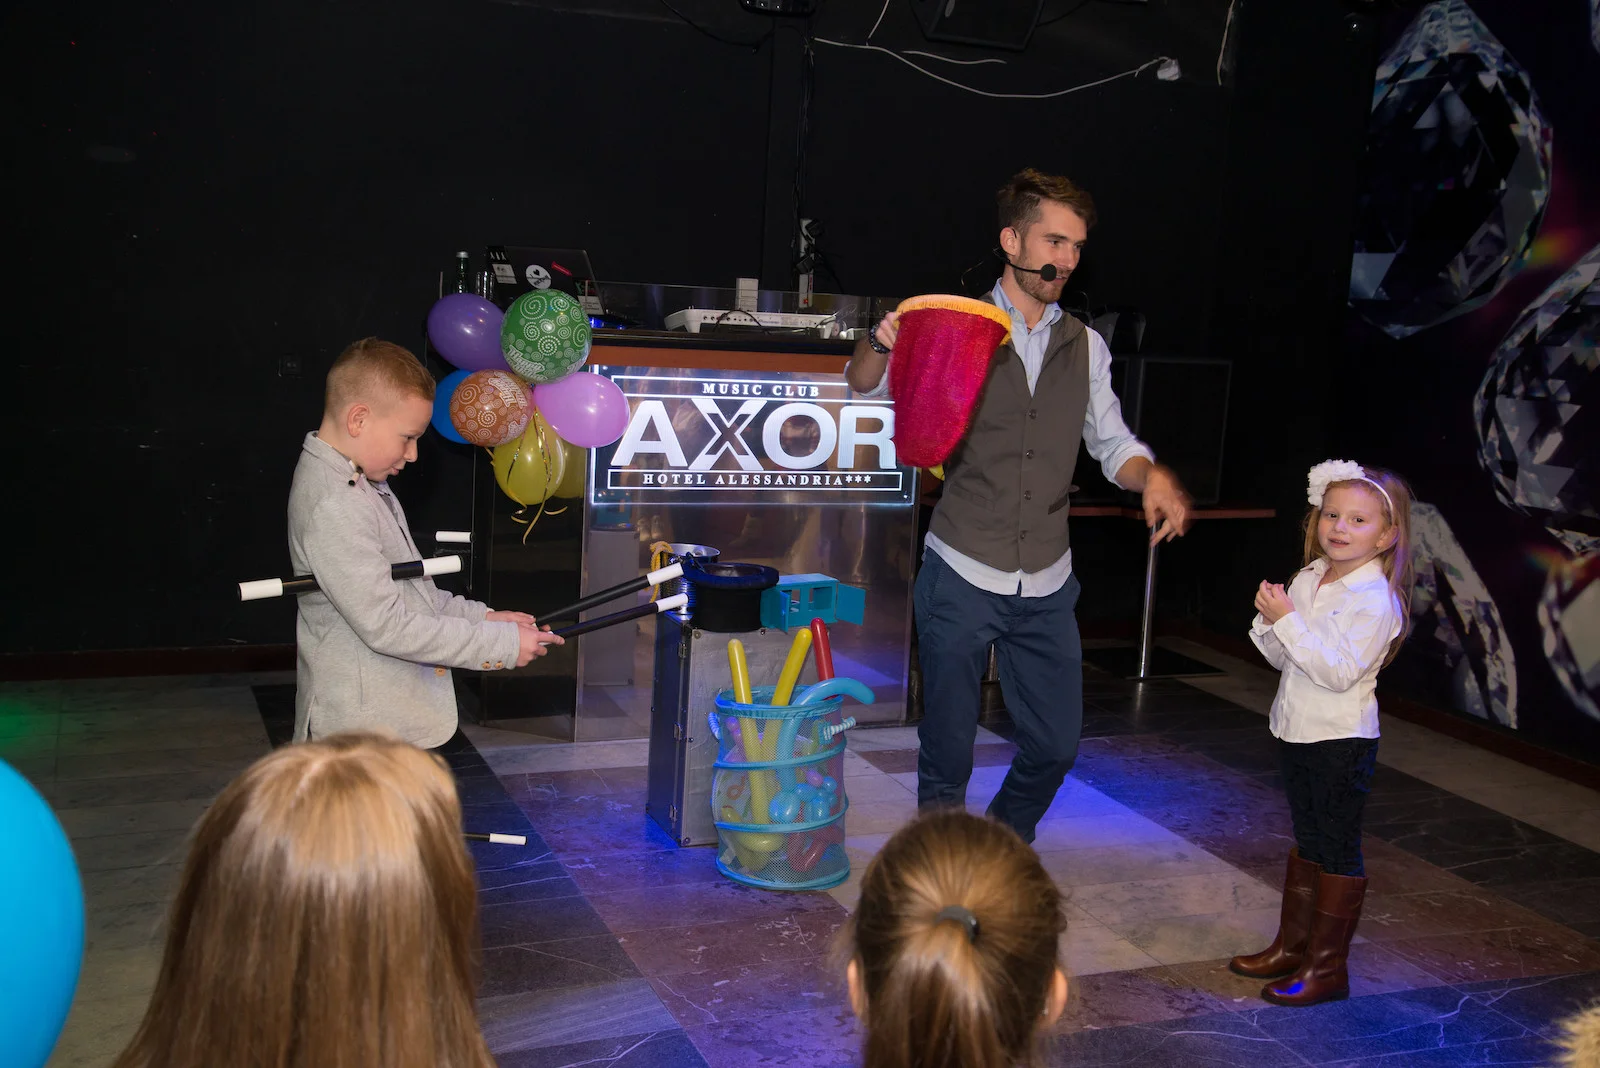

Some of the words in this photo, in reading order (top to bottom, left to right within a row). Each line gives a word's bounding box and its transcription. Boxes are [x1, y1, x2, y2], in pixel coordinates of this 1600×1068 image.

[703, 383, 762, 395] MUSIC
[772, 386, 819, 397] CLUB
[611, 398, 897, 471] AXOR
[643, 473, 707, 485] HOTEL
